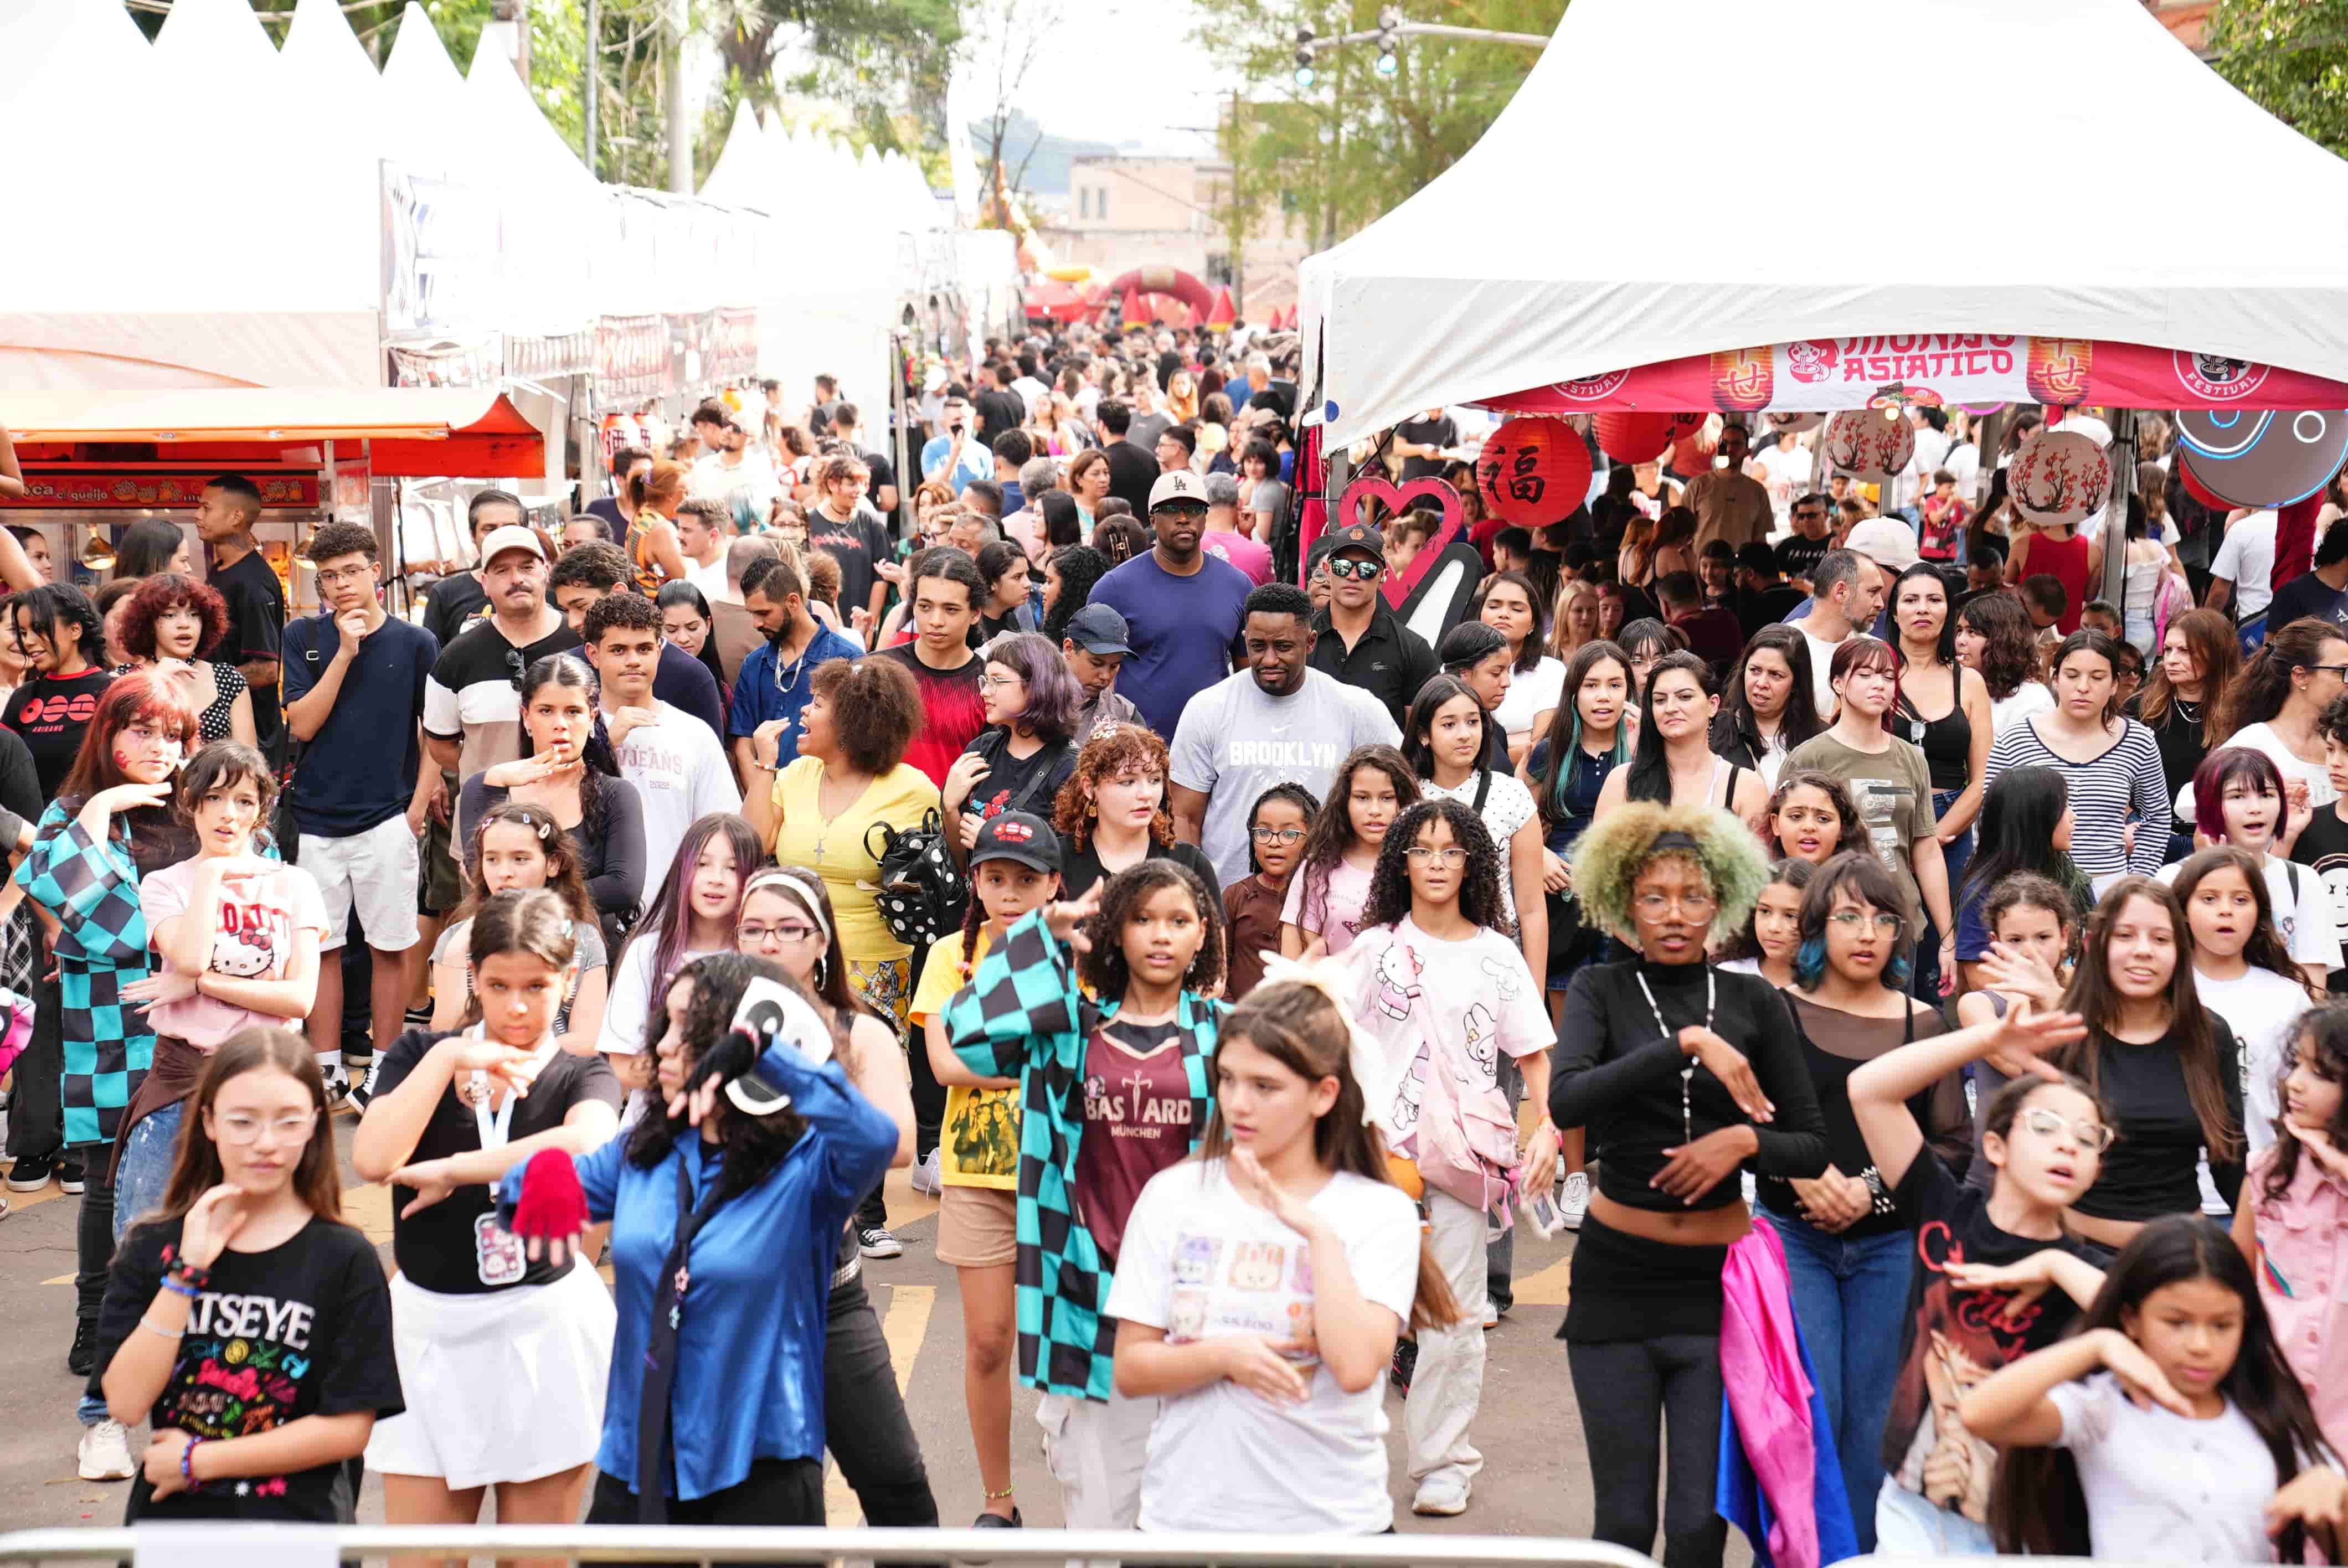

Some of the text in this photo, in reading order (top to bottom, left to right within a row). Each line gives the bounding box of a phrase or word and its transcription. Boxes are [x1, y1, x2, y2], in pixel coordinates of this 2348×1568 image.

[1561, 374, 1620, 395] ESTIVAL
[1173, 476, 1187, 491] LA
[1483, 445, 1546, 504] 福
[71, 487, 107, 501] queijo
[1229, 740, 1338, 768] BROOKLYN
[1111, 1123, 1161, 1139] MÜNCHEN
